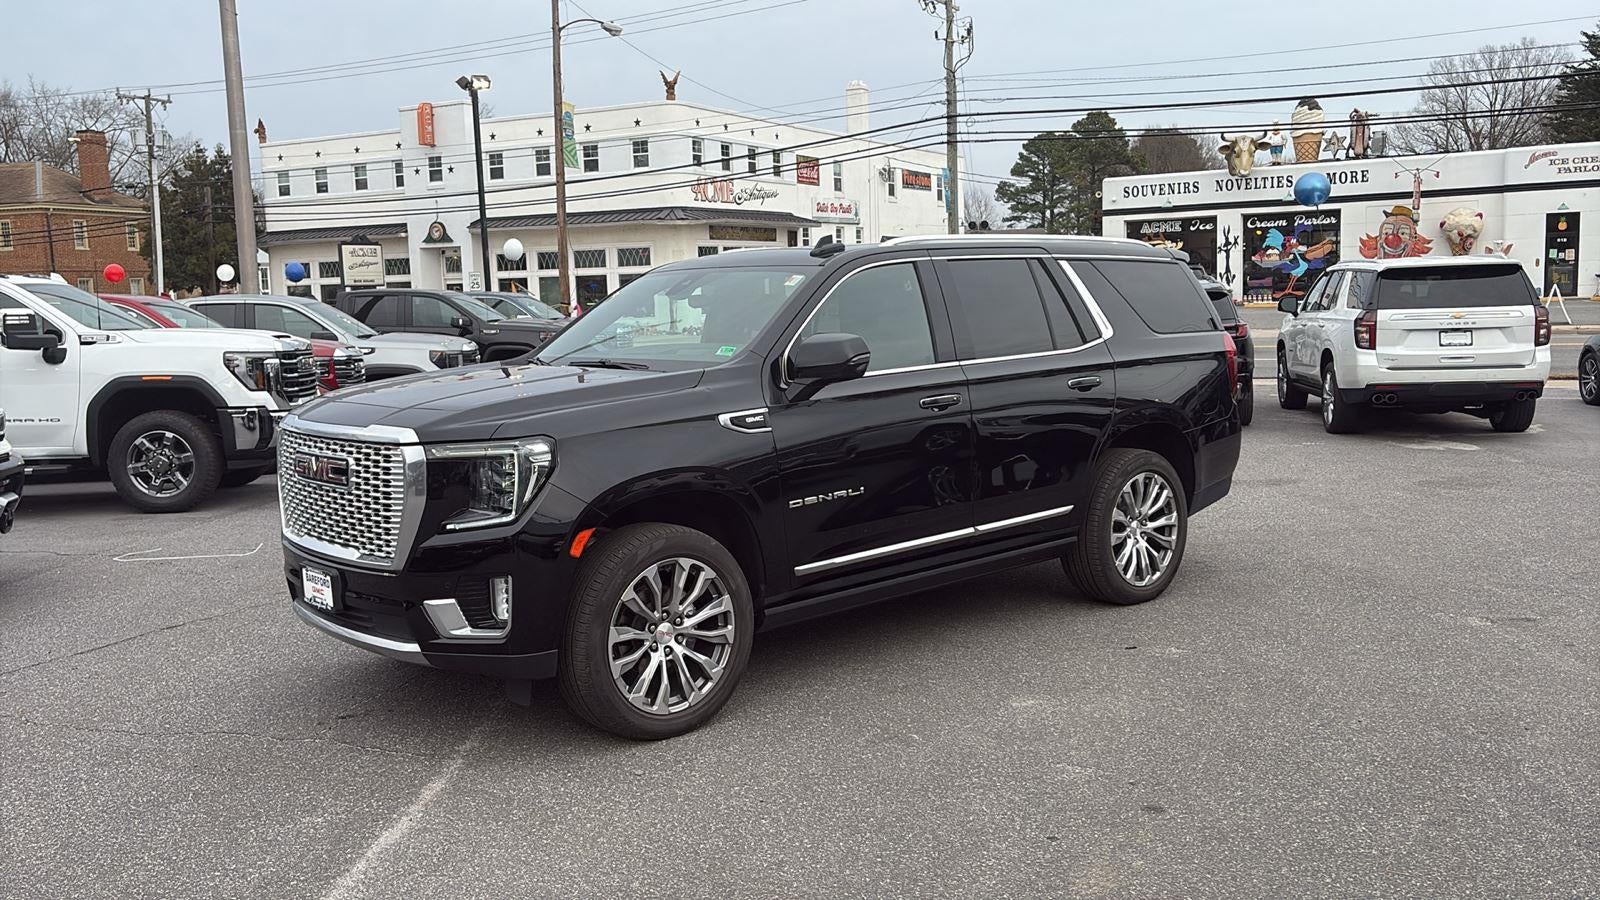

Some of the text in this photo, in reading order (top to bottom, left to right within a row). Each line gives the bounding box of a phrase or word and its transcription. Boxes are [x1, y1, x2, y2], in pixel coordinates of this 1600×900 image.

[1548, 157, 1570, 166] ICE
[691, 177, 735, 203] ACME
[1122, 169, 1370, 199] SOUVENIRS NOVELTIES MORE
[1139, 219, 1215, 234] ACME Ice
[1246, 213, 1338, 229] Cream Parlor
[471, 281, 481, 289] 25
[745, 414, 765, 424] GMC
[294, 453, 348, 486] GMC
[788, 486, 865, 509] DENALI
[305, 572, 330, 589] BAREFORD
[311, 585, 325, 596] GMC
